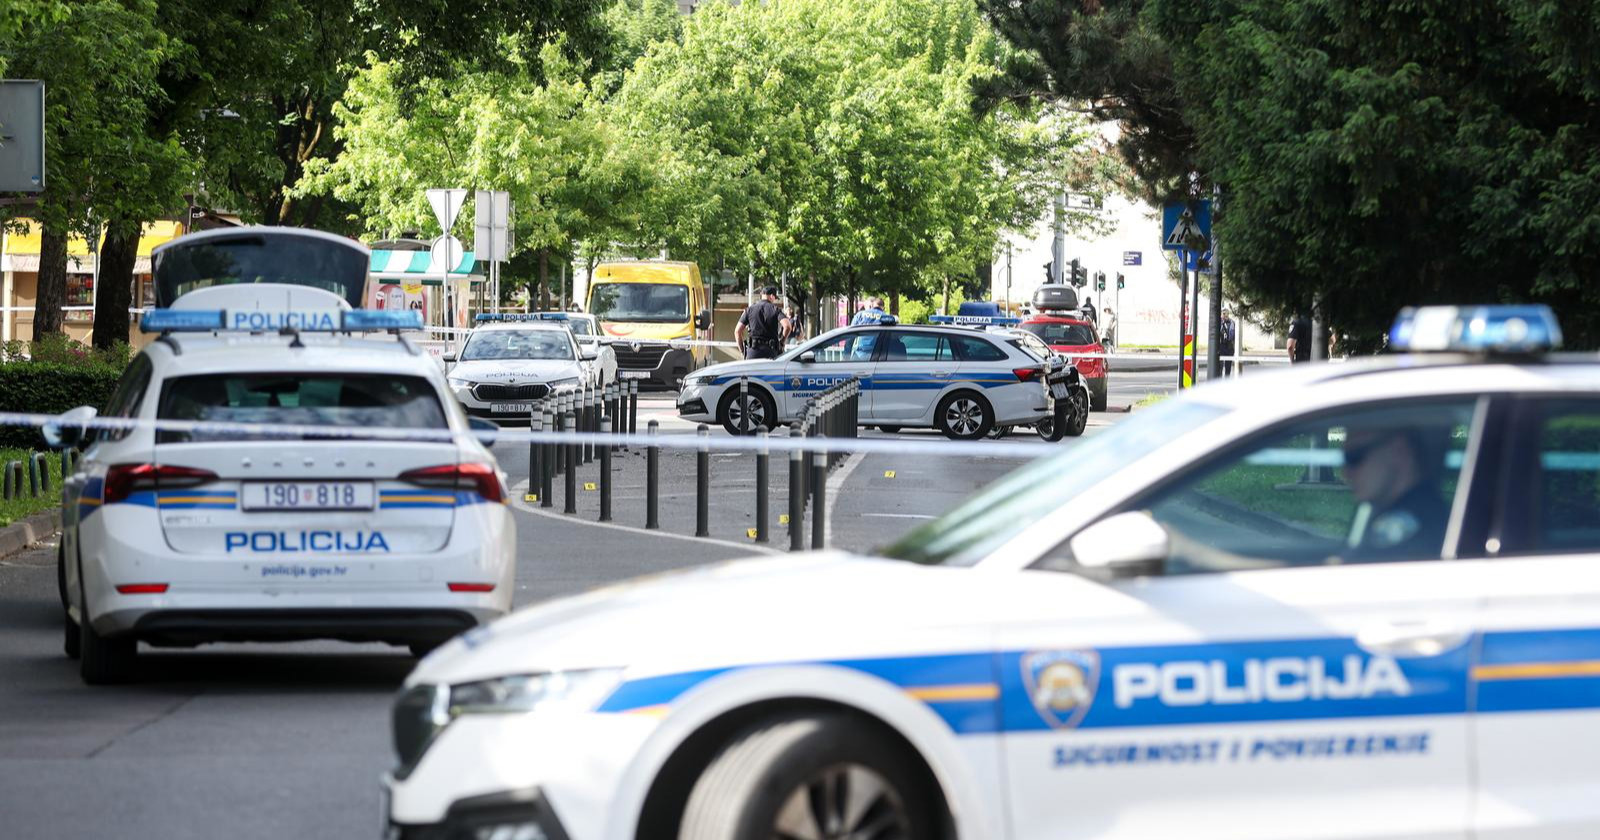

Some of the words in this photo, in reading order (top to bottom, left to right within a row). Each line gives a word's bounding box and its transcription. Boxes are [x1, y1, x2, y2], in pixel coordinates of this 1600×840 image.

[235, 312, 334, 330] POLICIJA
[264, 484, 299, 506] 190
[317, 484, 355, 506] 818
[225, 530, 391, 553] POLICIJA
[261, 563, 347, 578] policija.gov.hr
[1113, 655, 1412, 709] POLICIJA
[1052, 740, 1219, 769] SIGURNOST
[1249, 730, 1432, 759] POVJERENJE
